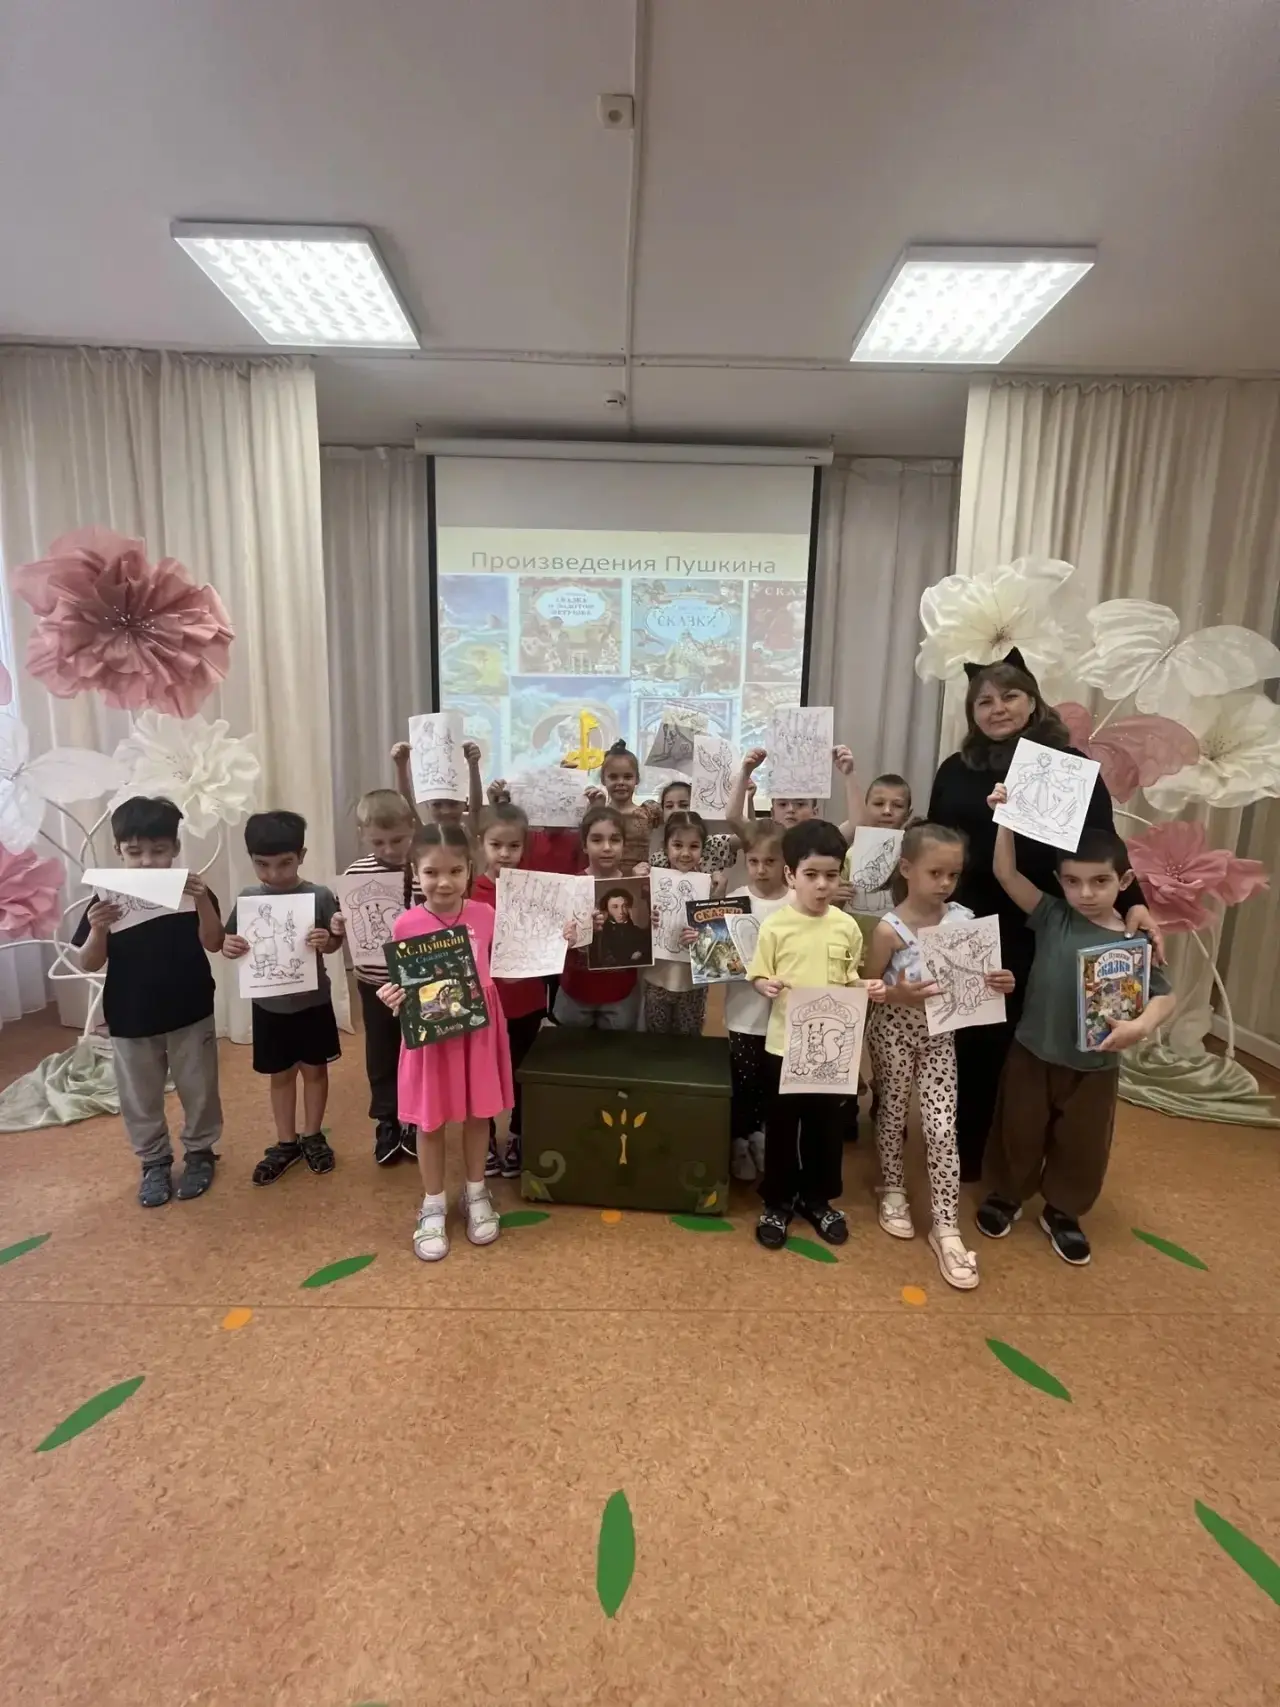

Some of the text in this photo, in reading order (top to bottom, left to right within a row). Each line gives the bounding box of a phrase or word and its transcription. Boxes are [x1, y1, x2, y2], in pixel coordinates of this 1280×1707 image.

[472, 551, 776, 576] Произведения Пушкина
[657, 615, 717, 627] СКАЗКИ
